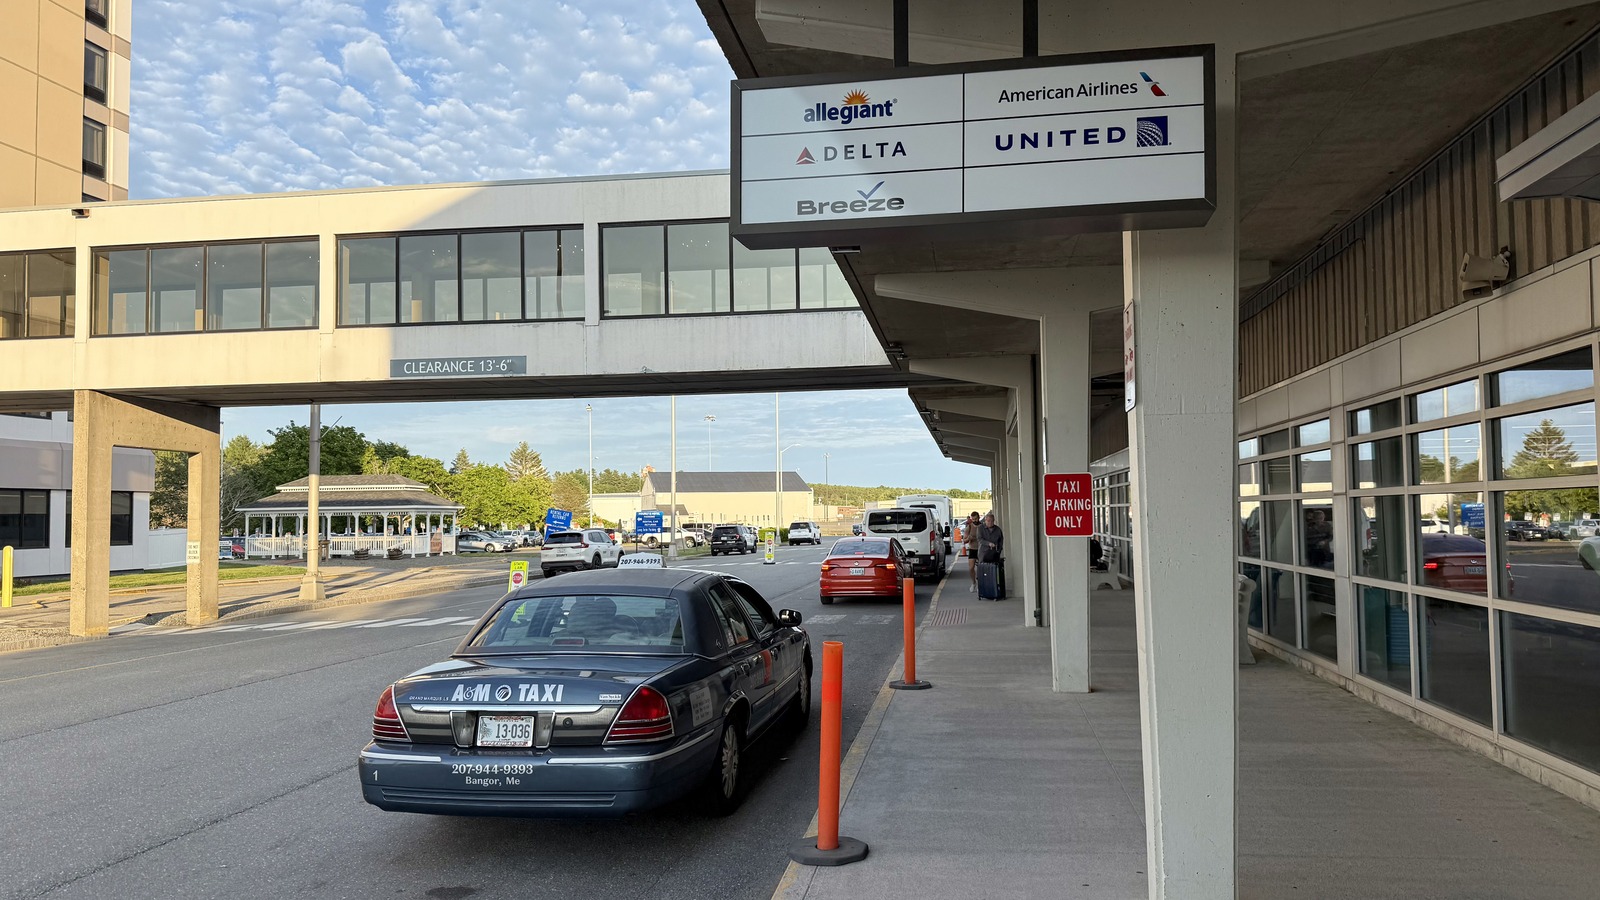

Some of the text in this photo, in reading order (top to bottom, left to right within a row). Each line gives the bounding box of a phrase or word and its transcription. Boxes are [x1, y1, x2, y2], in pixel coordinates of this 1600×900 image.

[998, 80, 1138, 104] American Airlines
[803, 100, 893, 124] allegiant
[995, 126, 1127, 151] UNITED
[824, 141, 907, 162] DELTA
[797, 196, 905, 216] Breeze
[403, 360, 475, 374] CLEARANCE
[1056, 481, 1080, 493] TAXI
[1046, 498, 1092, 511] PARKING
[1055, 516, 1083, 528] ONLY
[451, 684, 565, 702] A&M TAXI
[372, 770, 378, 781] 1
[452, 764, 534, 774] 207-944-9393
[466, 776, 520, 786] Bangor, Me
